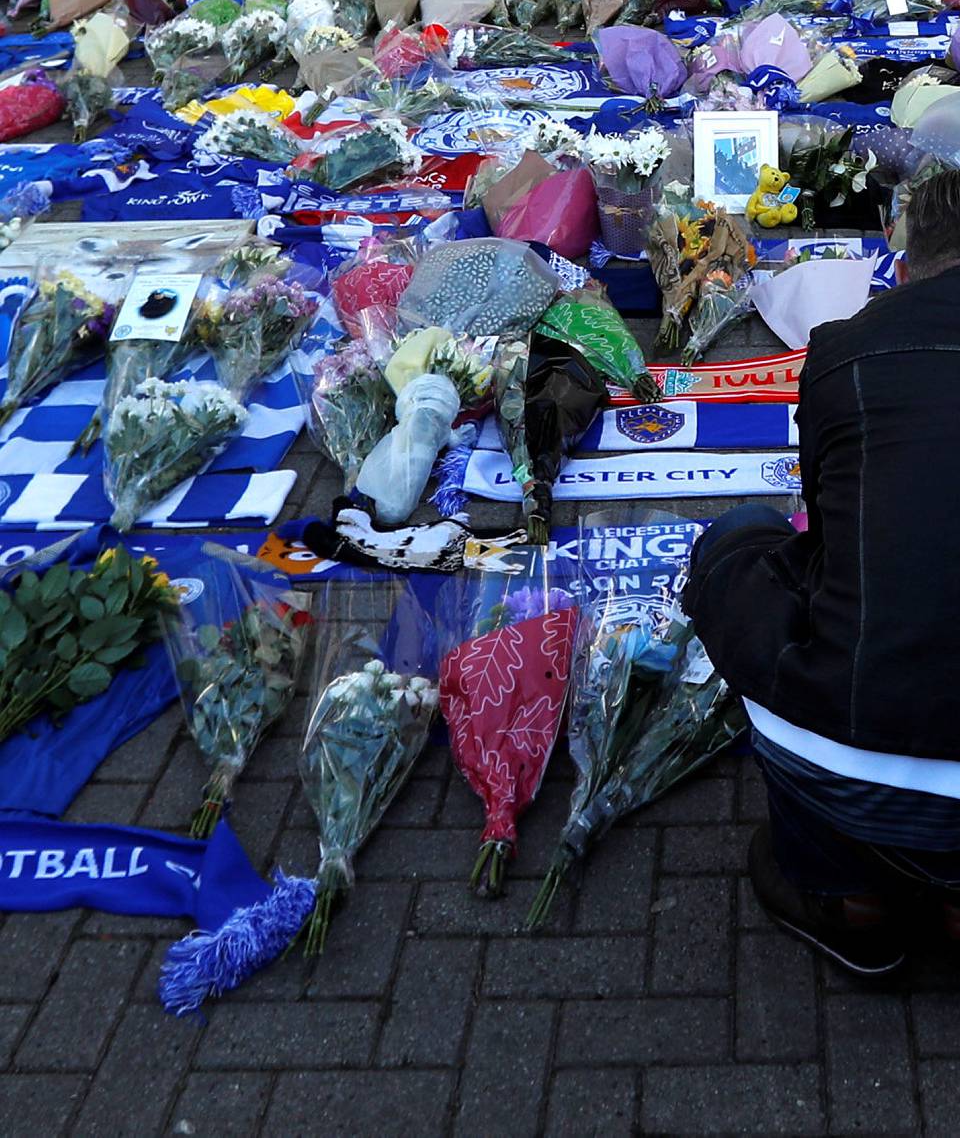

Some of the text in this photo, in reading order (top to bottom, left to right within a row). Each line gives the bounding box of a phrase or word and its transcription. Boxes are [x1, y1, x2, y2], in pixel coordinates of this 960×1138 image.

[283, 190, 452, 212] ICESTER
[495, 468, 738, 485] LESTER CITY
[592, 523, 701, 538] LEICESTER
[595, 557, 652, 570] CHAT
[0, 847, 149, 880] TBALL
